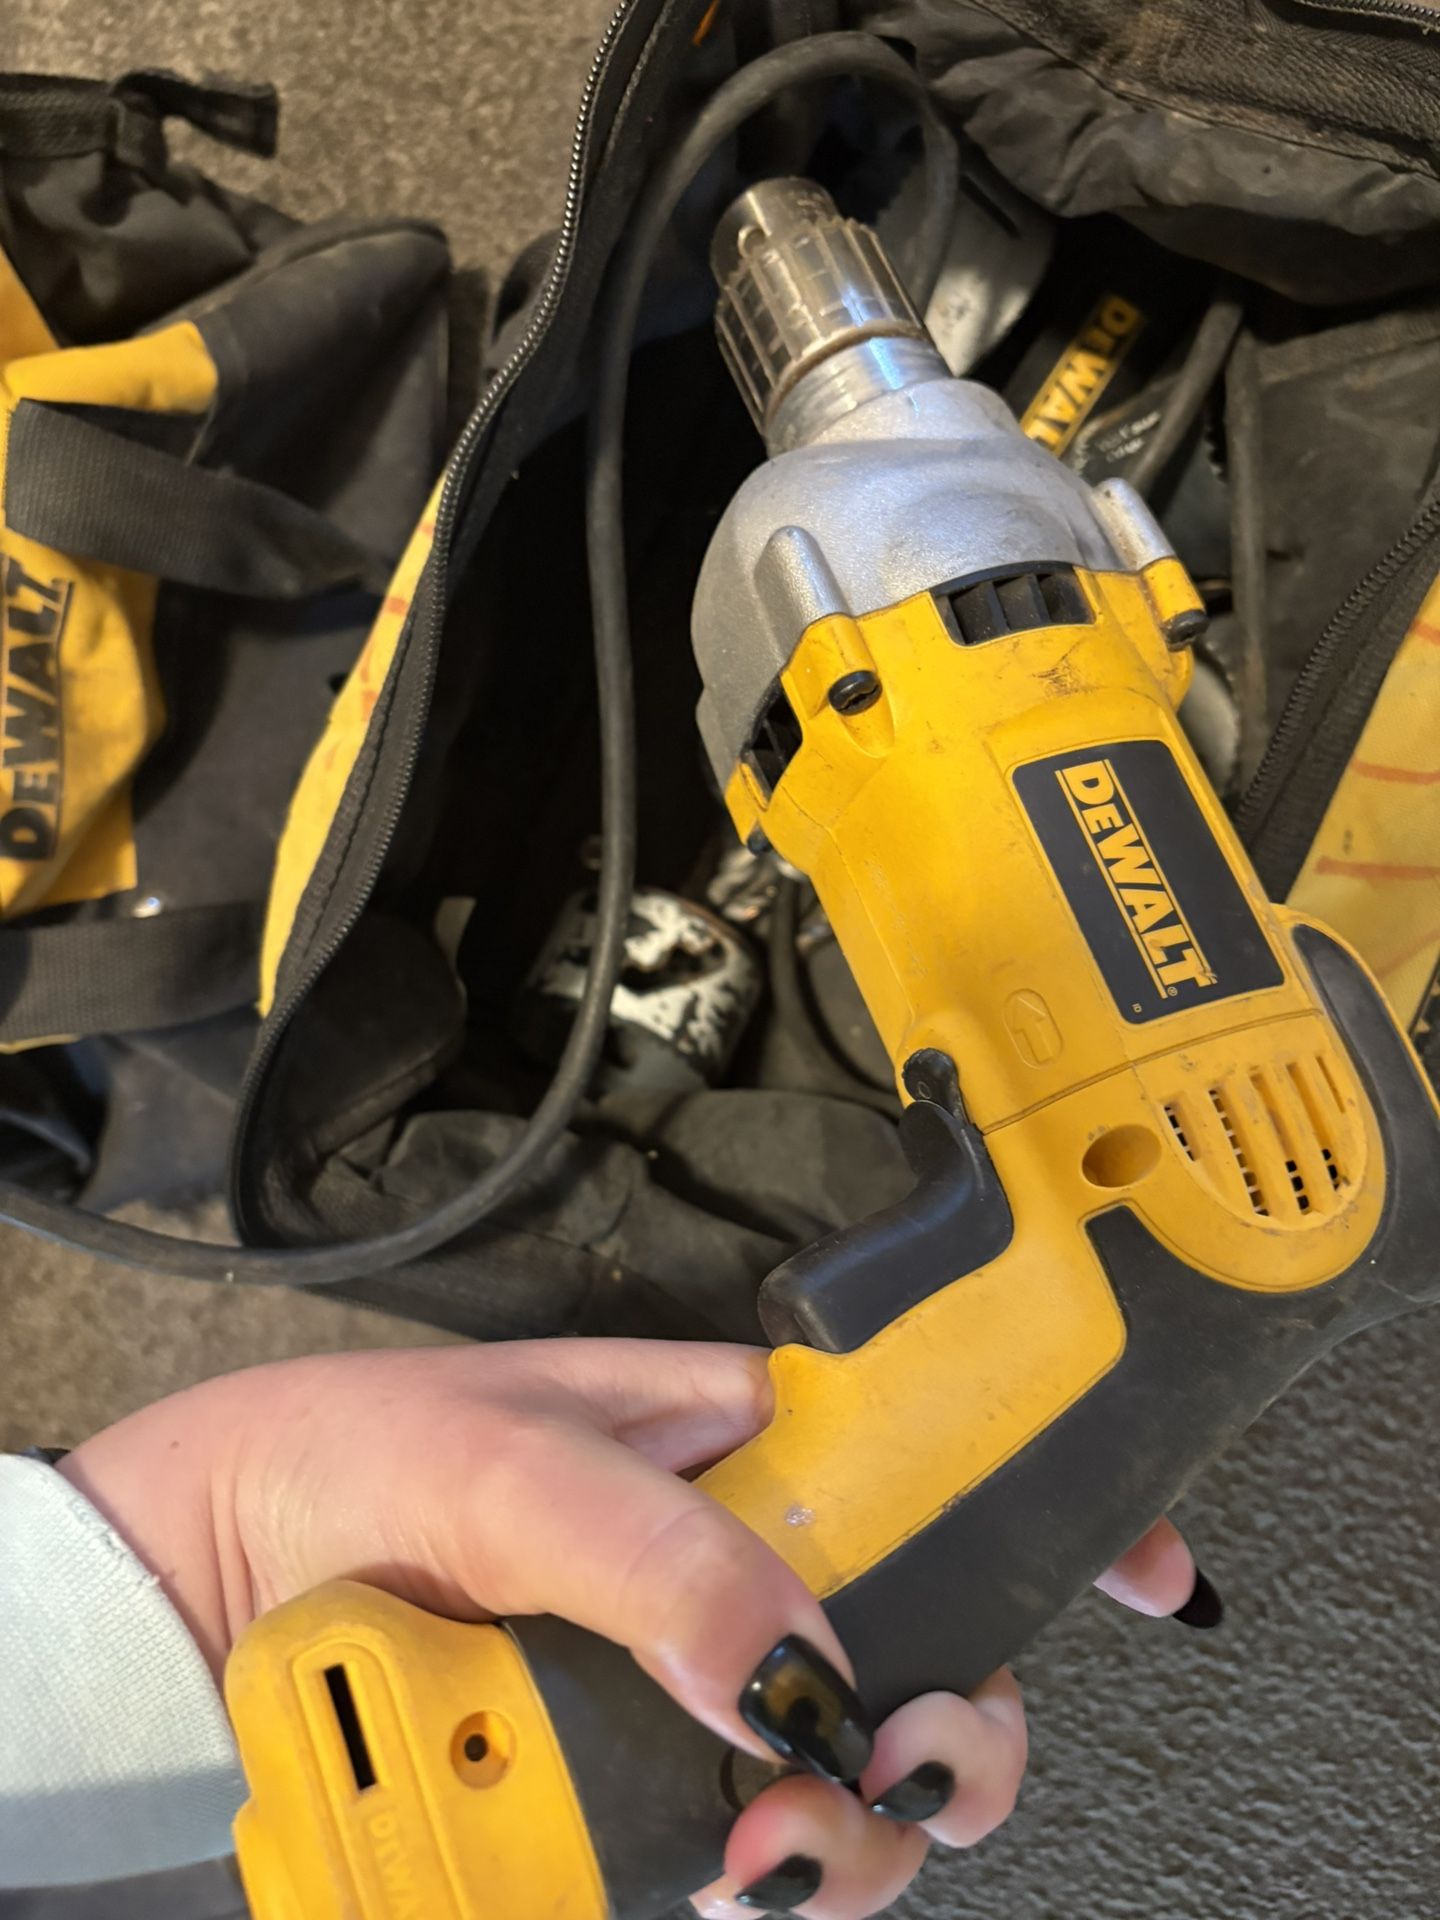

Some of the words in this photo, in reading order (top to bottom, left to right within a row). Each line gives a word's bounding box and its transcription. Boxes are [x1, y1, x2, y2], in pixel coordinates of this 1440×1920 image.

[1022, 295, 1141, 452] DEWAL
[0, 556, 64, 861] DEWALT
[1058, 759, 1215, 990] DEWALT
